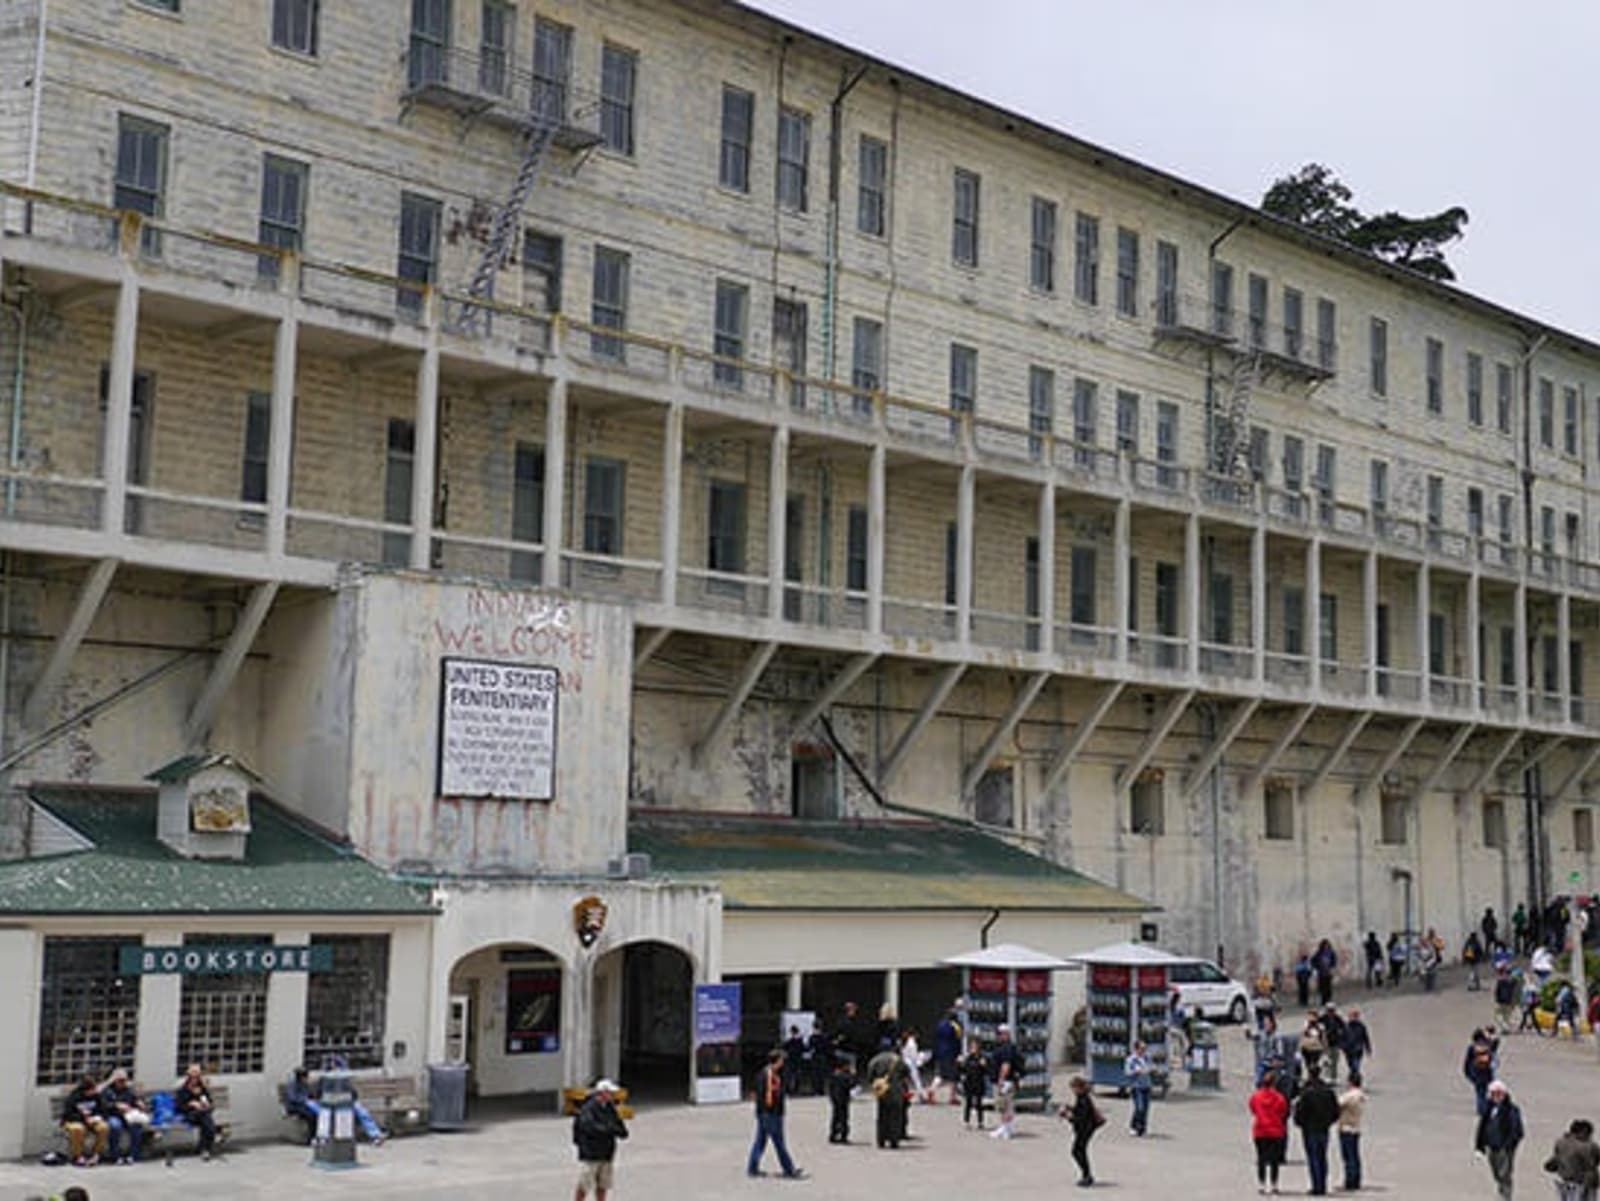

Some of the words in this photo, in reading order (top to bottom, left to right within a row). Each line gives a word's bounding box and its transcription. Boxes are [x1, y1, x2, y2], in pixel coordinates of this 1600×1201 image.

[435, 619, 595, 661] WELCOME
[450, 666, 500, 688] UNITED
[503, 670, 556, 692] STATES
[450, 688, 550, 712] PENITENTIARY
[143, 951, 309, 970] BOOKSTORE
